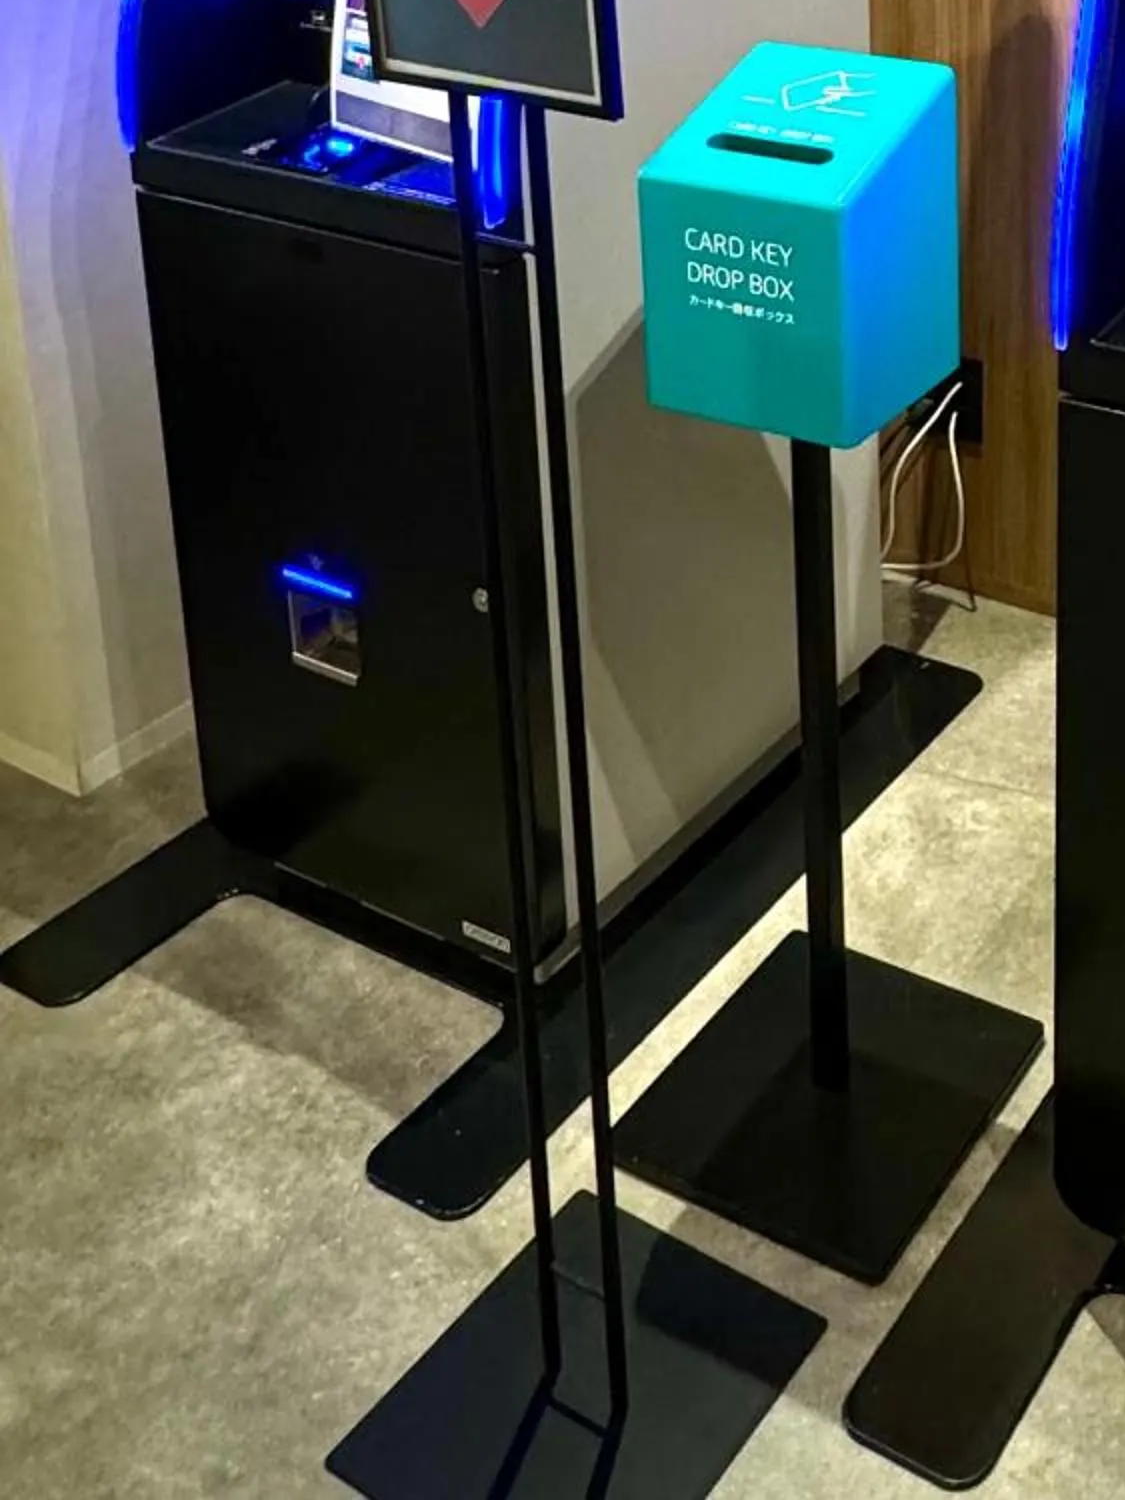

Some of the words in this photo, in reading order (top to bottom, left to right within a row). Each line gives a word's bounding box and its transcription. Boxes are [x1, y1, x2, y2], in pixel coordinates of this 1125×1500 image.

[685, 227, 745, 259] CARD
[750, 239, 793, 268] KEY
[687, 260, 745, 291] DROP
[748, 272, 796, 303] BOX
